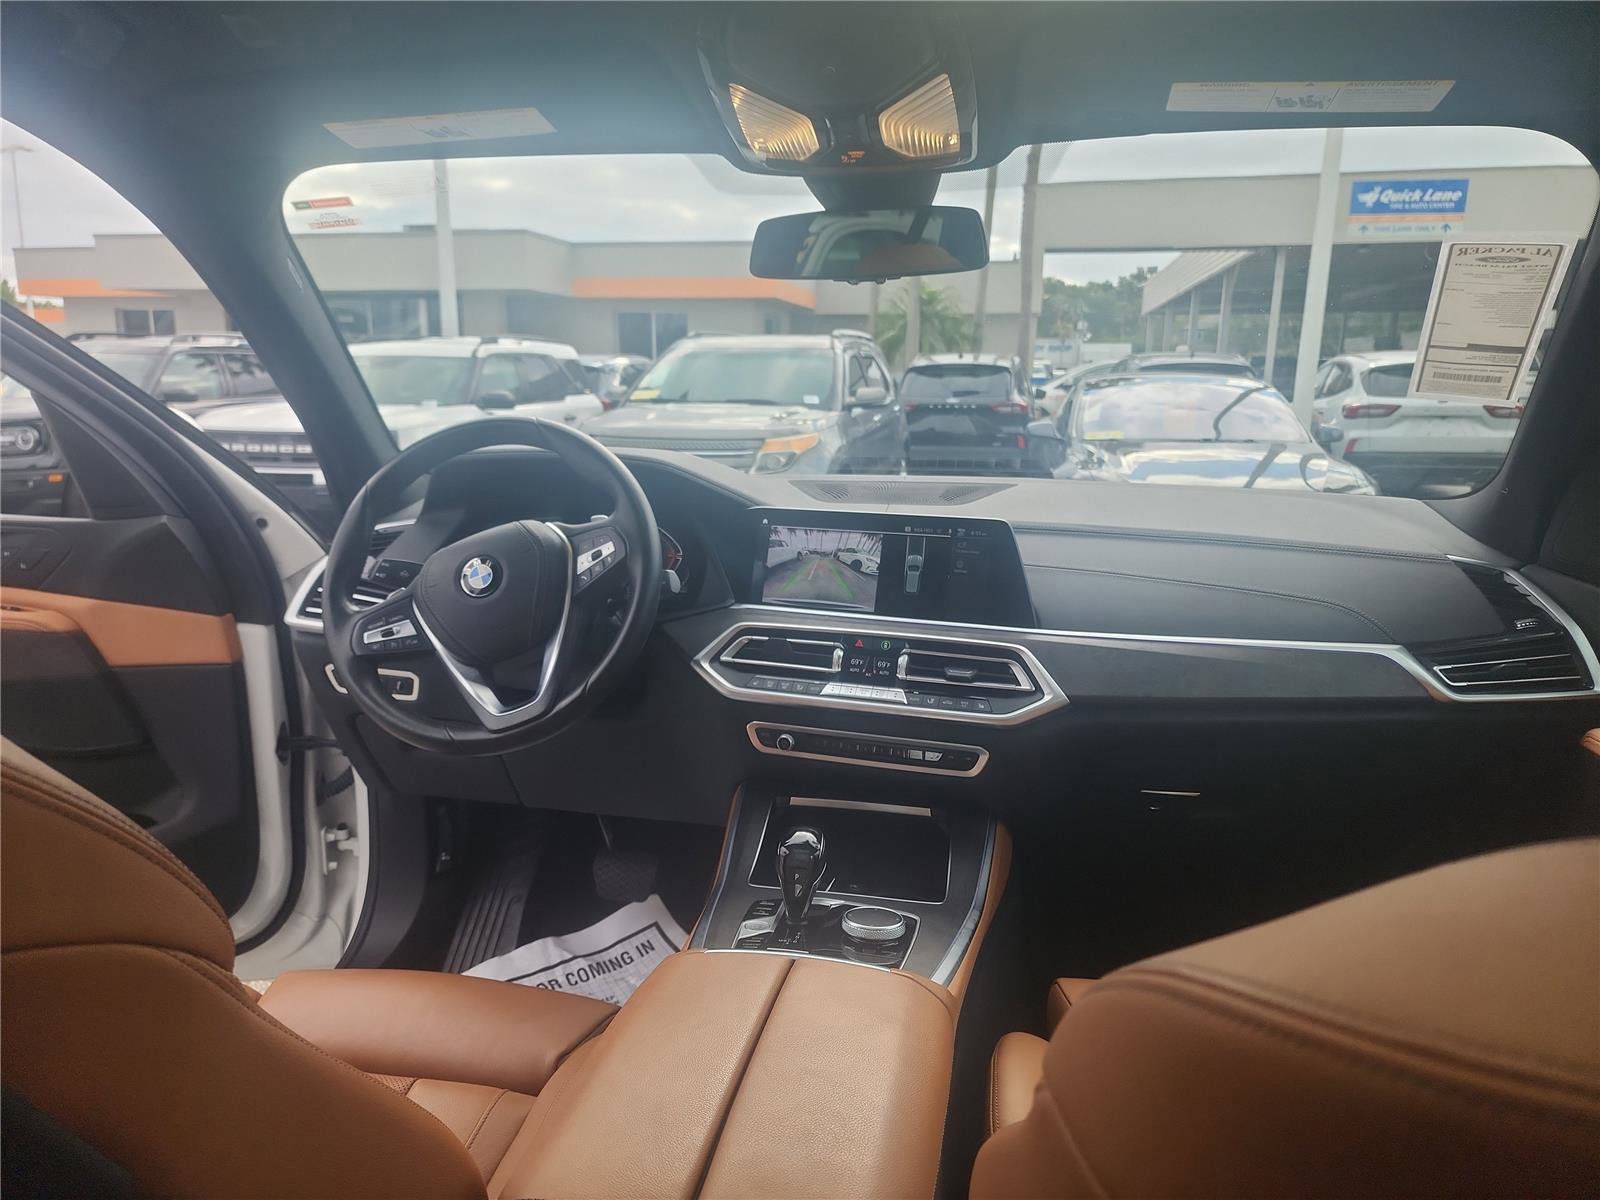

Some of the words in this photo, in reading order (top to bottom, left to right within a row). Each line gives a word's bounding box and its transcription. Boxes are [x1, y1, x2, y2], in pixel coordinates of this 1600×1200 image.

[1379, 188, 1422, 204] Quick
[1422, 188, 1462, 202] Lane
[1428, 201, 1455, 209] CENTER
[565, 951, 634, 986] COMING
[635, 939, 655, 957] IN
